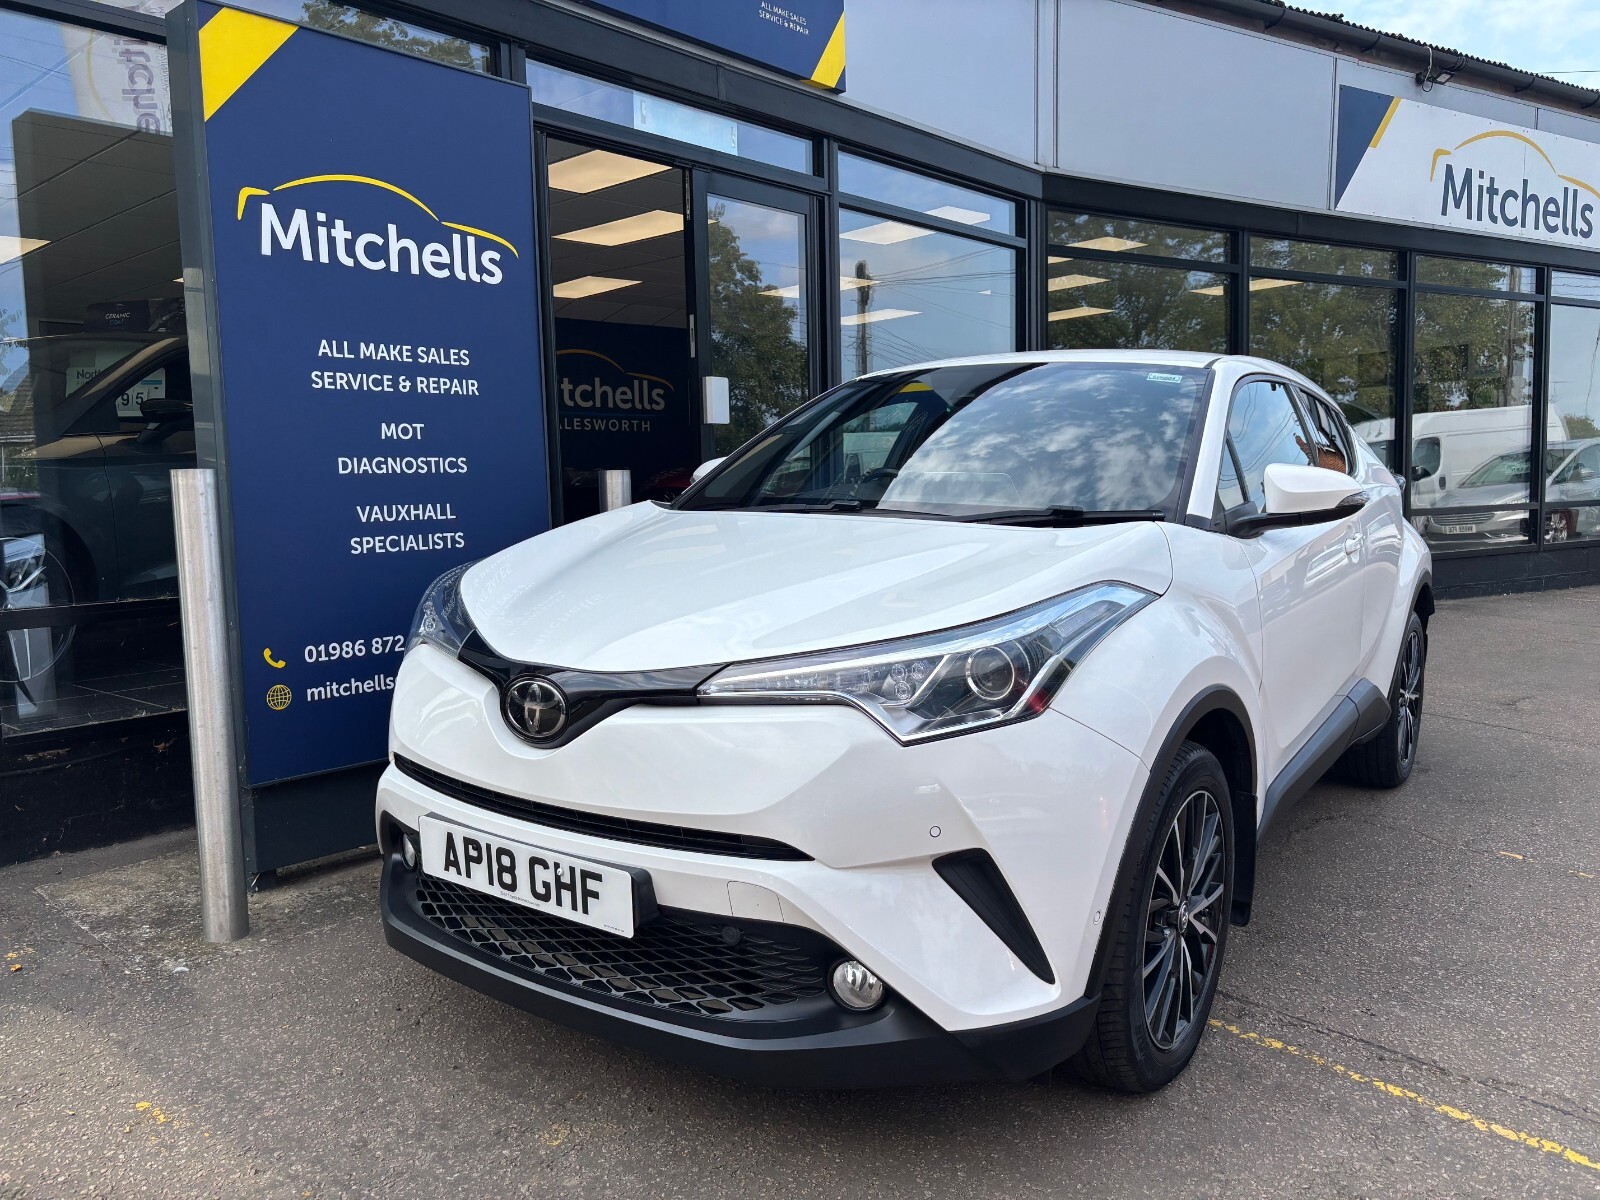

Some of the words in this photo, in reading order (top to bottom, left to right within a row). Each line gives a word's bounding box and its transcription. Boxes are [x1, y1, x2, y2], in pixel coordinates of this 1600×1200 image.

[758, 9, 783, 26] SERVICE
[789, 22, 810, 36] REPAIR
[760, 1, 773, 12] ALL
[772, 5, 789, 19] MAKE
[789, 12, 807, 26] SALES
[1441, 163, 1594, 239] Mitchells
[261, 202, 503, 285] Mitchells
[317, 339, 355, 359] ALL
[359, 341, 413, 362] MAKE
[417, 346, 470, 366] SALES
[311, 371, 394, 392] SERVICE
[398, 375, 411, 393] &
[416, 376, 480, 396] REPAIR
[560, 377, 666, 411] tchells
[381, 422, 425, 440] MOT
[559, 417, 651, 432] LESWORTH
[337, 456, 468, 474] DIAGNOSTICS
[356, 503, 457, 523] VAUXHALL
[350, 532, 465, 555] SPECIALISTS
[304, 639, 366, 663] 01986
[306, 673, 397, 702] mitchells
[443, 831, 518, 893] AP18
[528, 855, 603, 915] GHF
